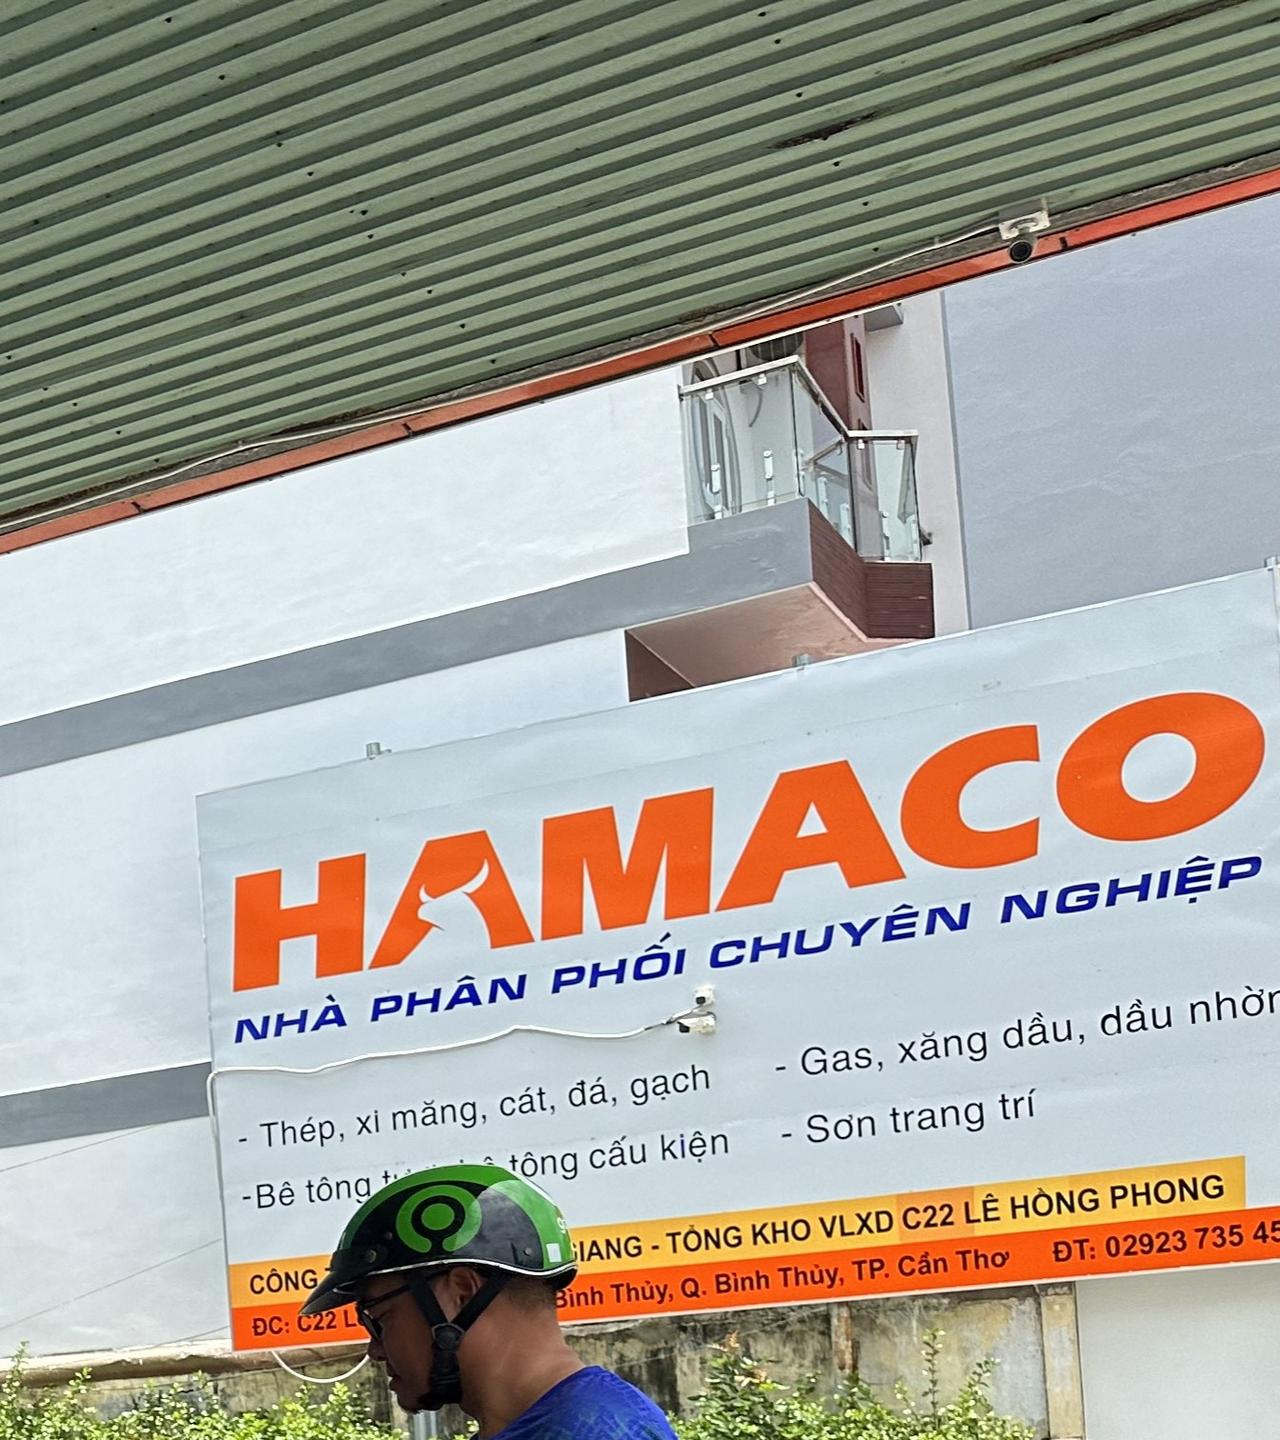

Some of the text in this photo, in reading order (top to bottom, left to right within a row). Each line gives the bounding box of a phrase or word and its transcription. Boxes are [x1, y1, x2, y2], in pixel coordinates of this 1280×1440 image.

[233, 691, 1266, 993] HAMACO
[235, 856, 1262, 1044] NHÀ PHÂN PHỐI CHUYÊN NGHIỆP
[801, 1046, 883, 1075] Gas,
[898, 1031, 988, 1062] xăng
[1003, 1012, 1085, 1049] dầu,
[1100, 999, 1172, 1036] dầu
[259, 1116, 345, 1147] Thép,
[357, 1110, 380, 1136] xi
[392, 1099, 487, 1129] măng,
[499, 1086, 555, 1116] cát,
[568, 1076, 617, 1107] đá,
[630, 1064, 710, 1105] gạch
[807, 1114, 876, 1143] Sơn
[890, 1101, 985, 1132] trang
[998, 1088, 1036, 1120] trí
[510, 1152, 578, 1180] tông
[590, 1135, 646, 1169] cấu
[661, 1130, 729, 1163] kiện
[307, 1177, 371, 1203] tông
[666, 1225, 742, 1253] TỔNG
[751, 1218, 811, 1245] KHO
[819, 1209, 895, 1239] VLXD
[902, 1204, 955, 1230] C22
[964, 1193, 1002, 1225] LÊ
[1010, 1187, 1100, 1219] HỒNG
[1110, 1174, 1225, 1209] PHONG
[1053, 1238, 1096, 1263] ĐT:
[1105, 1229, 1188, 1258] 02923
[1195, 1223, 1244, 1249] 735
[250, 1268, 318, 1295] CÔNG
[555, 1282, 604, 1309] Bình
[610, 1279, 674, 1305] Thủy,
[680, 1277, 707, 1299] Q.
[715, 1269, 770, 1294] Bình
[777, 1263, 844, 1289] Thủy,
[851, 1258, 890, 1281] TP.
[956, 1246, 1010, 1273] Thơ
[252, 1315, 290, 1336] ĐC:
[297, 1311, 337, 1332] C22
